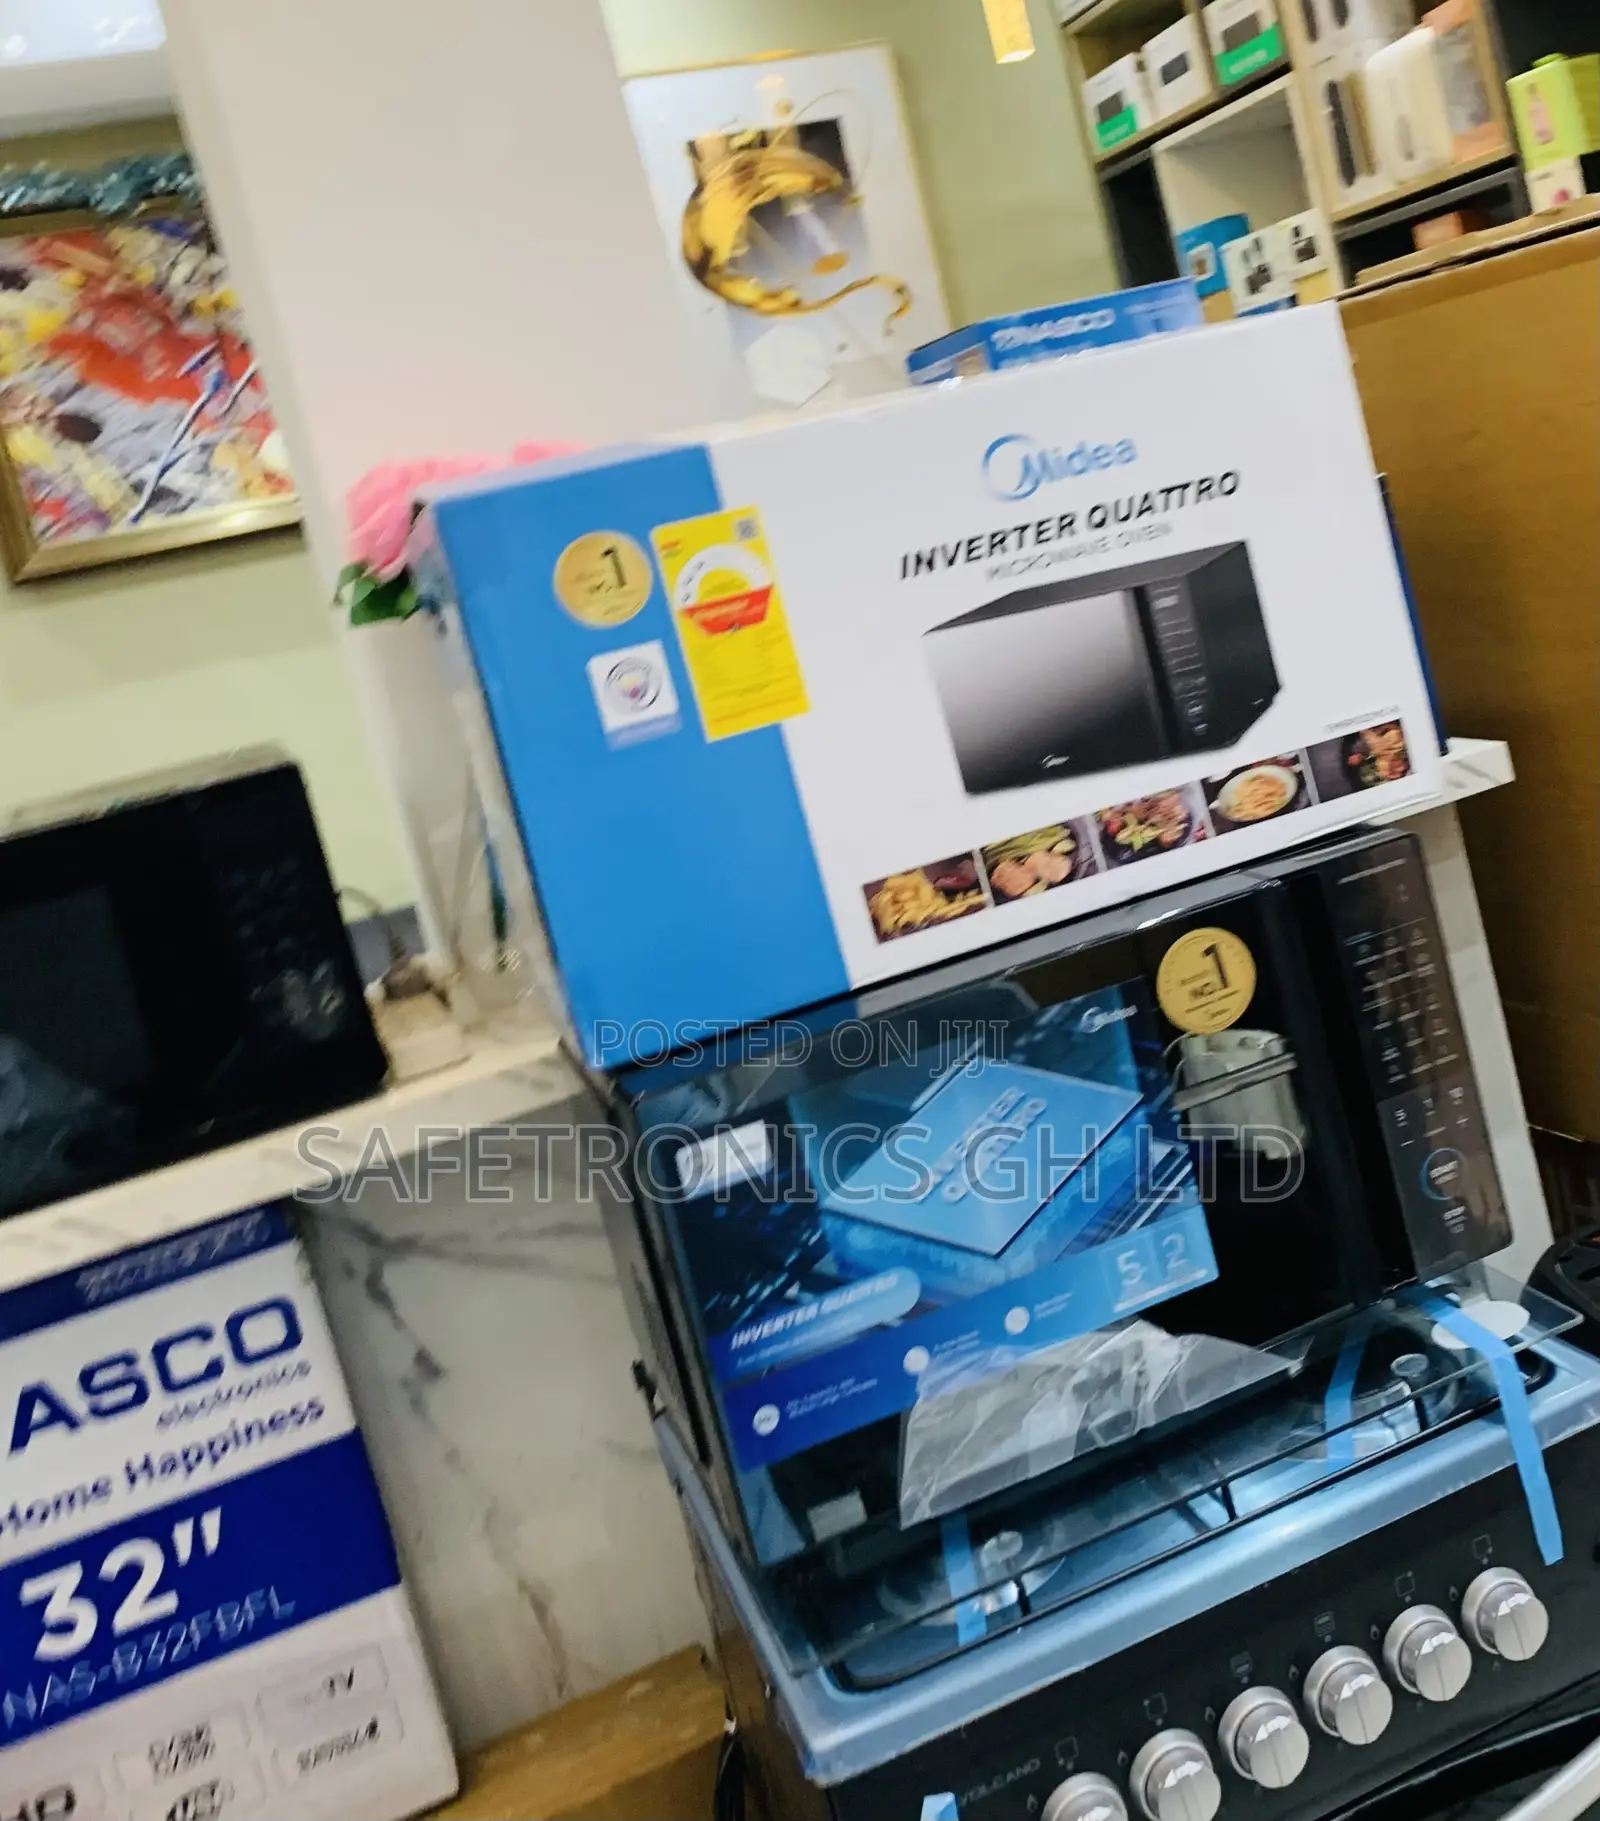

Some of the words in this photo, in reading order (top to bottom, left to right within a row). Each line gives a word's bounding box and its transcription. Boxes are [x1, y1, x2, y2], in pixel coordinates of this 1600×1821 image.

[990, 434, 1139, 500] Midea
[900, 512, 1079, 581] INVERTER
[1087, 470, 1242, 530] QUATTRO
[1202, 943, 1229, 989] 1
[124, 1395, 326, 1494] Happiness
